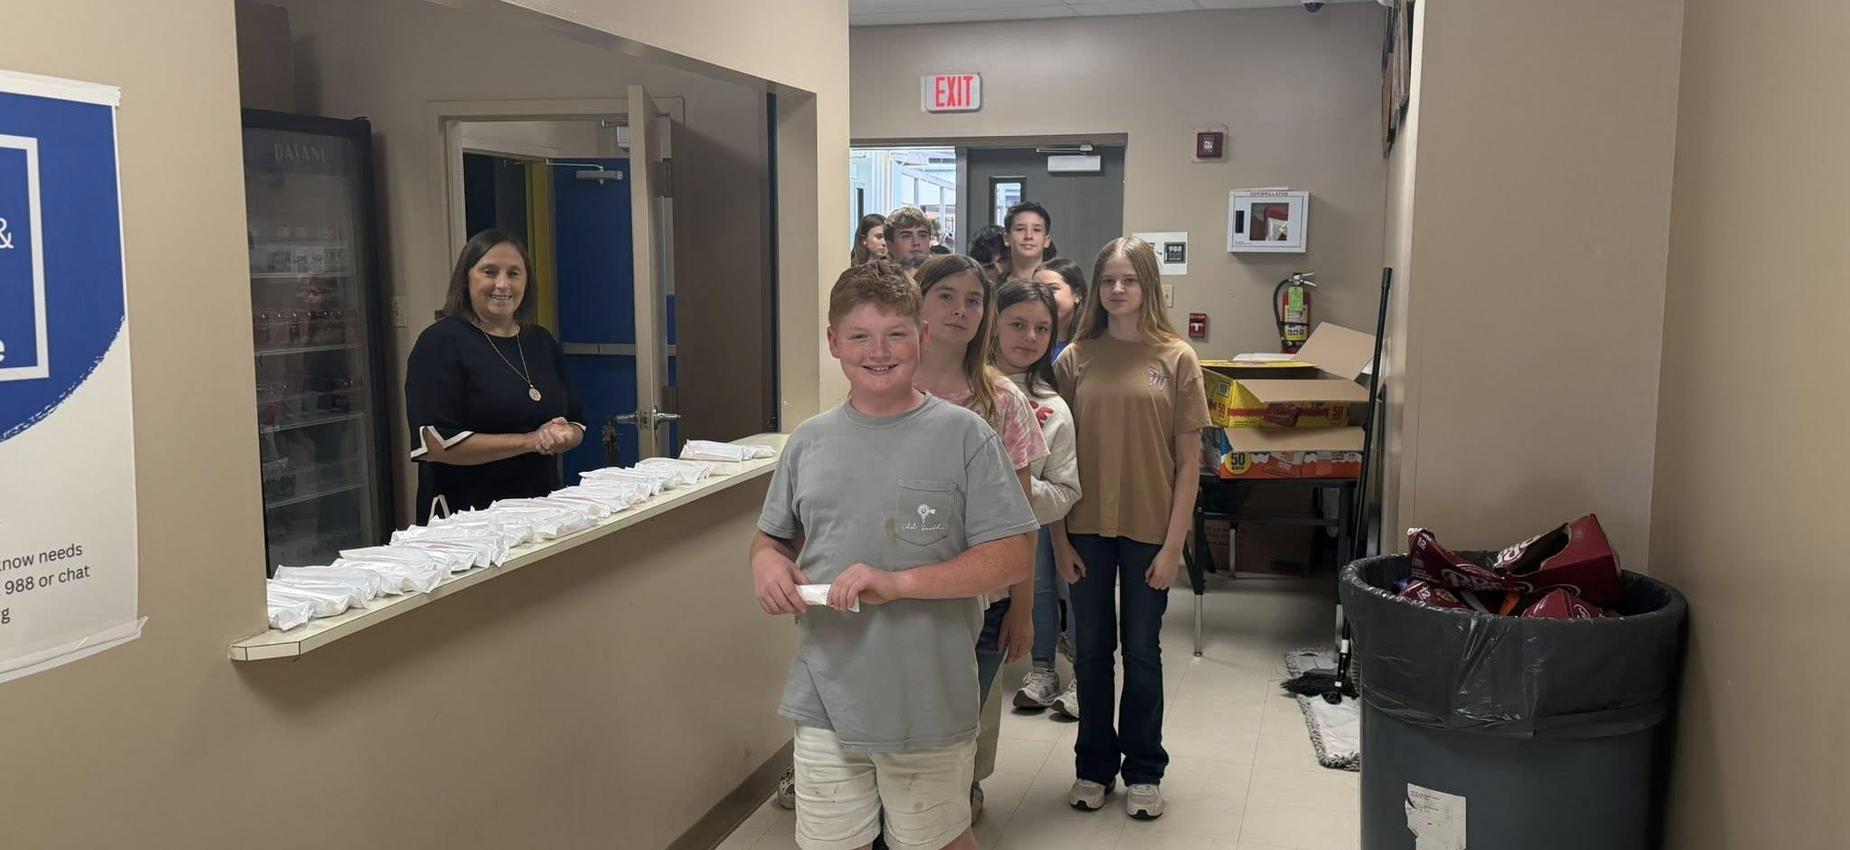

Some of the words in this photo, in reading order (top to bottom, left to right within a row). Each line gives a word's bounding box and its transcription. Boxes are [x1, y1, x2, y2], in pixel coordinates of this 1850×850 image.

[935, 76, 973, 107] EXIT
[0, 217, 14, 249] &
[1231, 452, 1246, 466] 50
[39, 543, 83, 564] needs
[5, 576, 34, 595] 988
[38, 574, 54, 588] or
[58, 565, 90, 583] chat
[1417, 586, 1431, 600] 12
